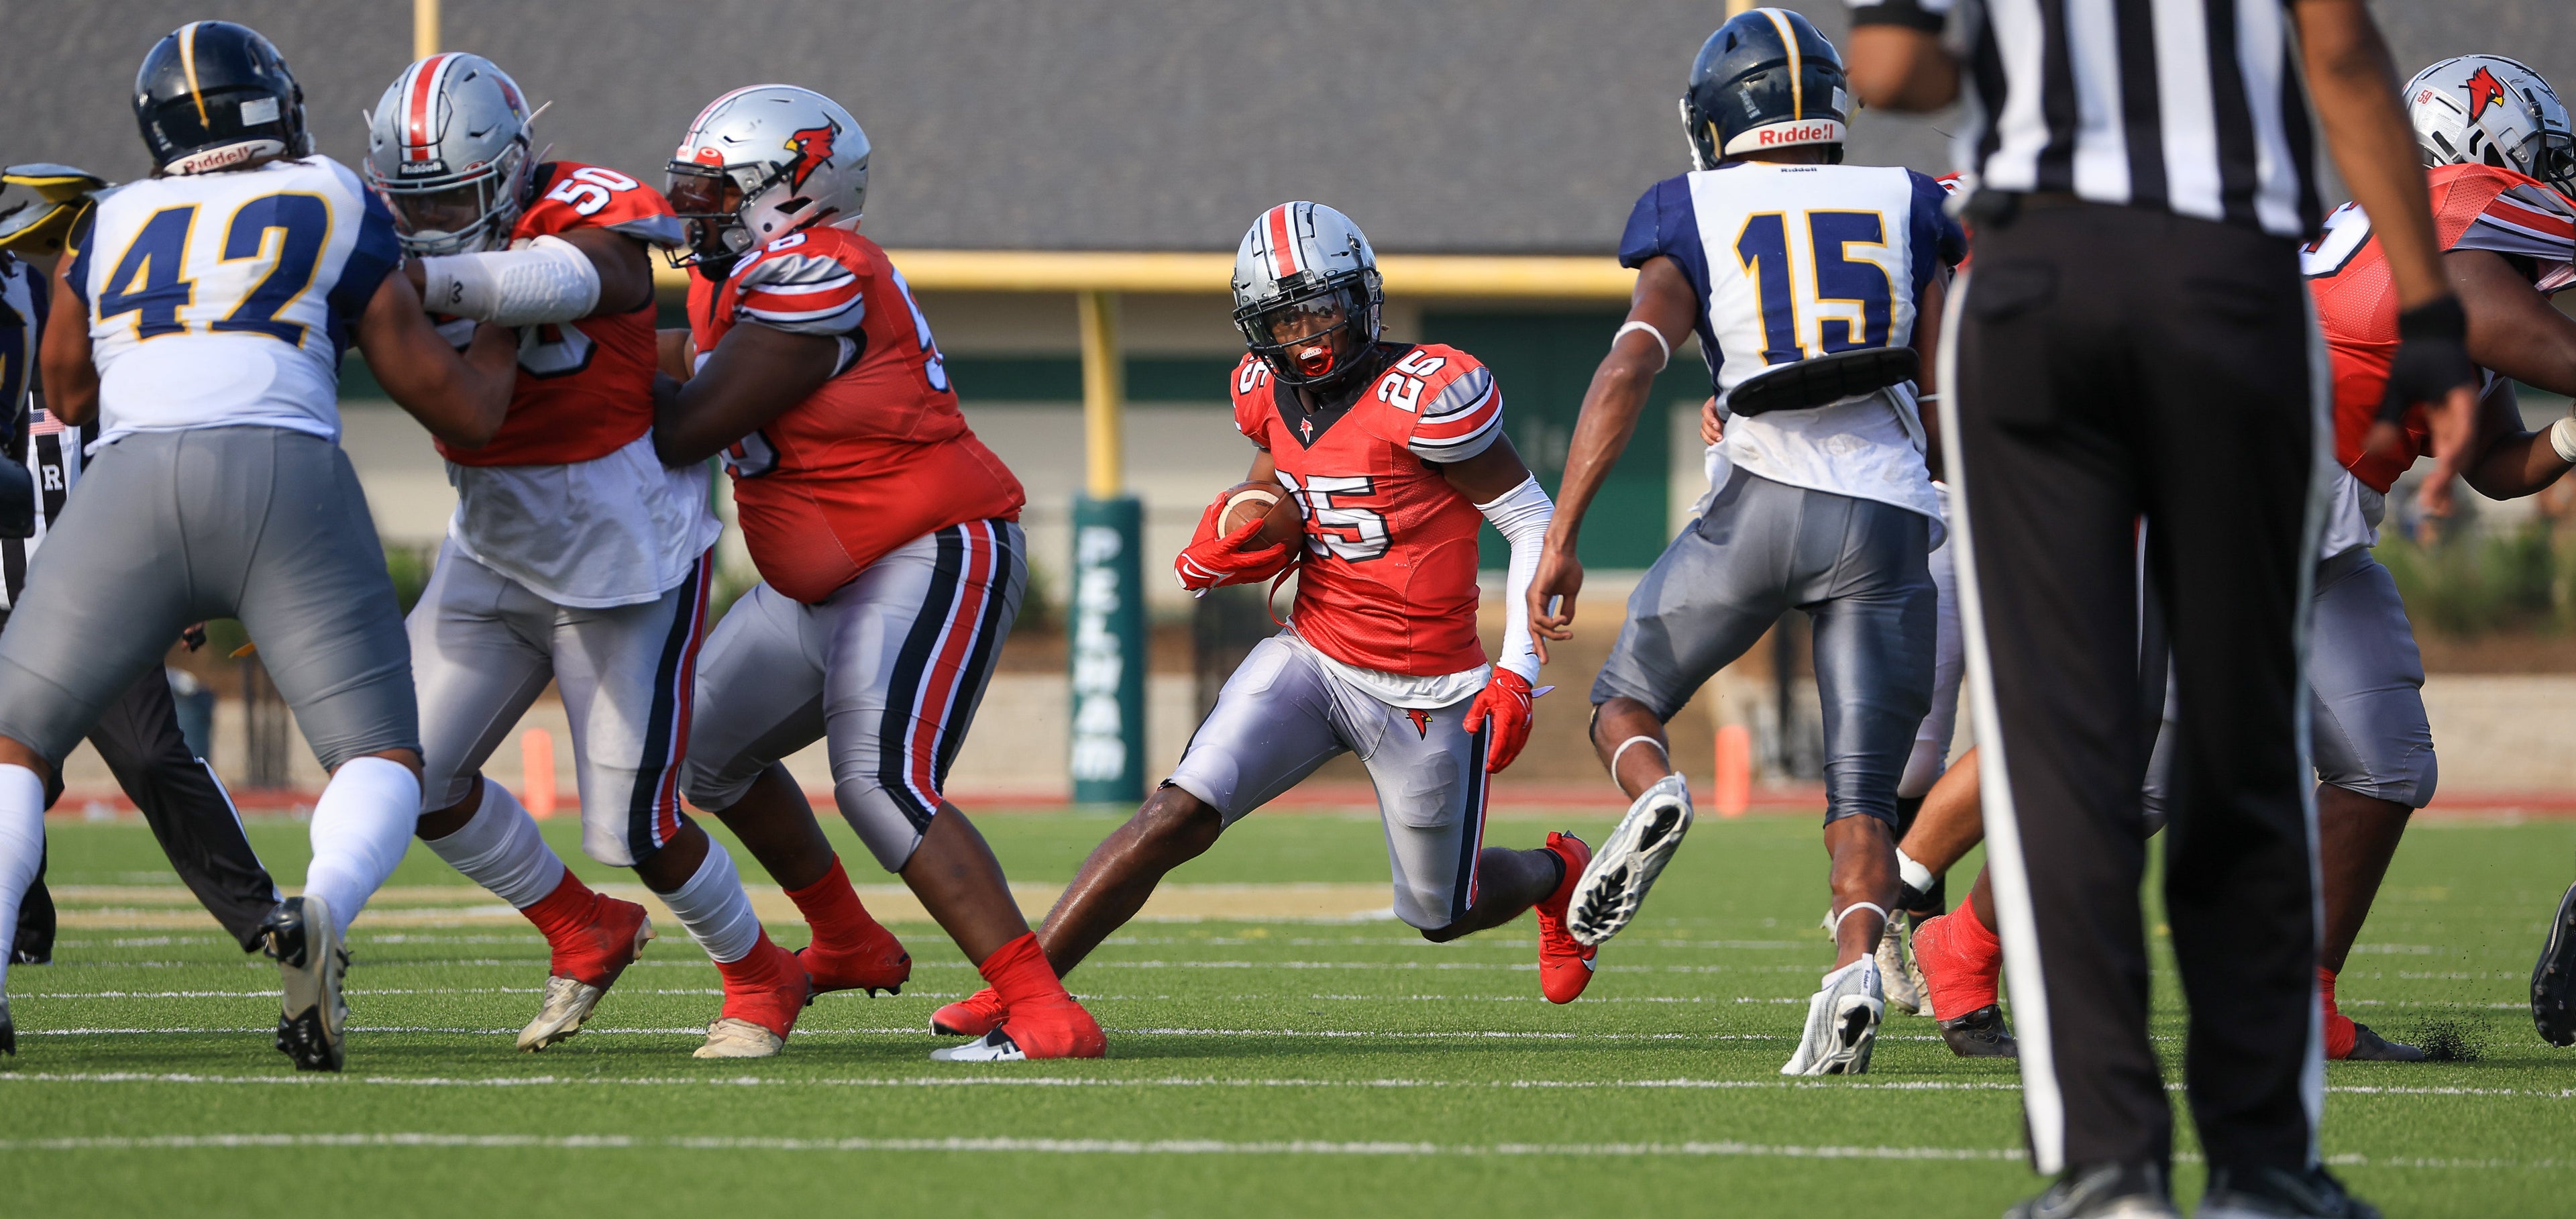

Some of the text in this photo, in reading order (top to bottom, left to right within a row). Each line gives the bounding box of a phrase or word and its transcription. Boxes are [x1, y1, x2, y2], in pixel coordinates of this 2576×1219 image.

[2418, 90, 2432, 104] 59
[1760, 123, 1833, 146] Riddell
[545, 168, 639, 215] 50
[98, 192, 333, 349] 42
[1733, 210, 1895, 366] 15
[1377, 350, 1446, 413] 25
[42, 464, 62, 490] R
